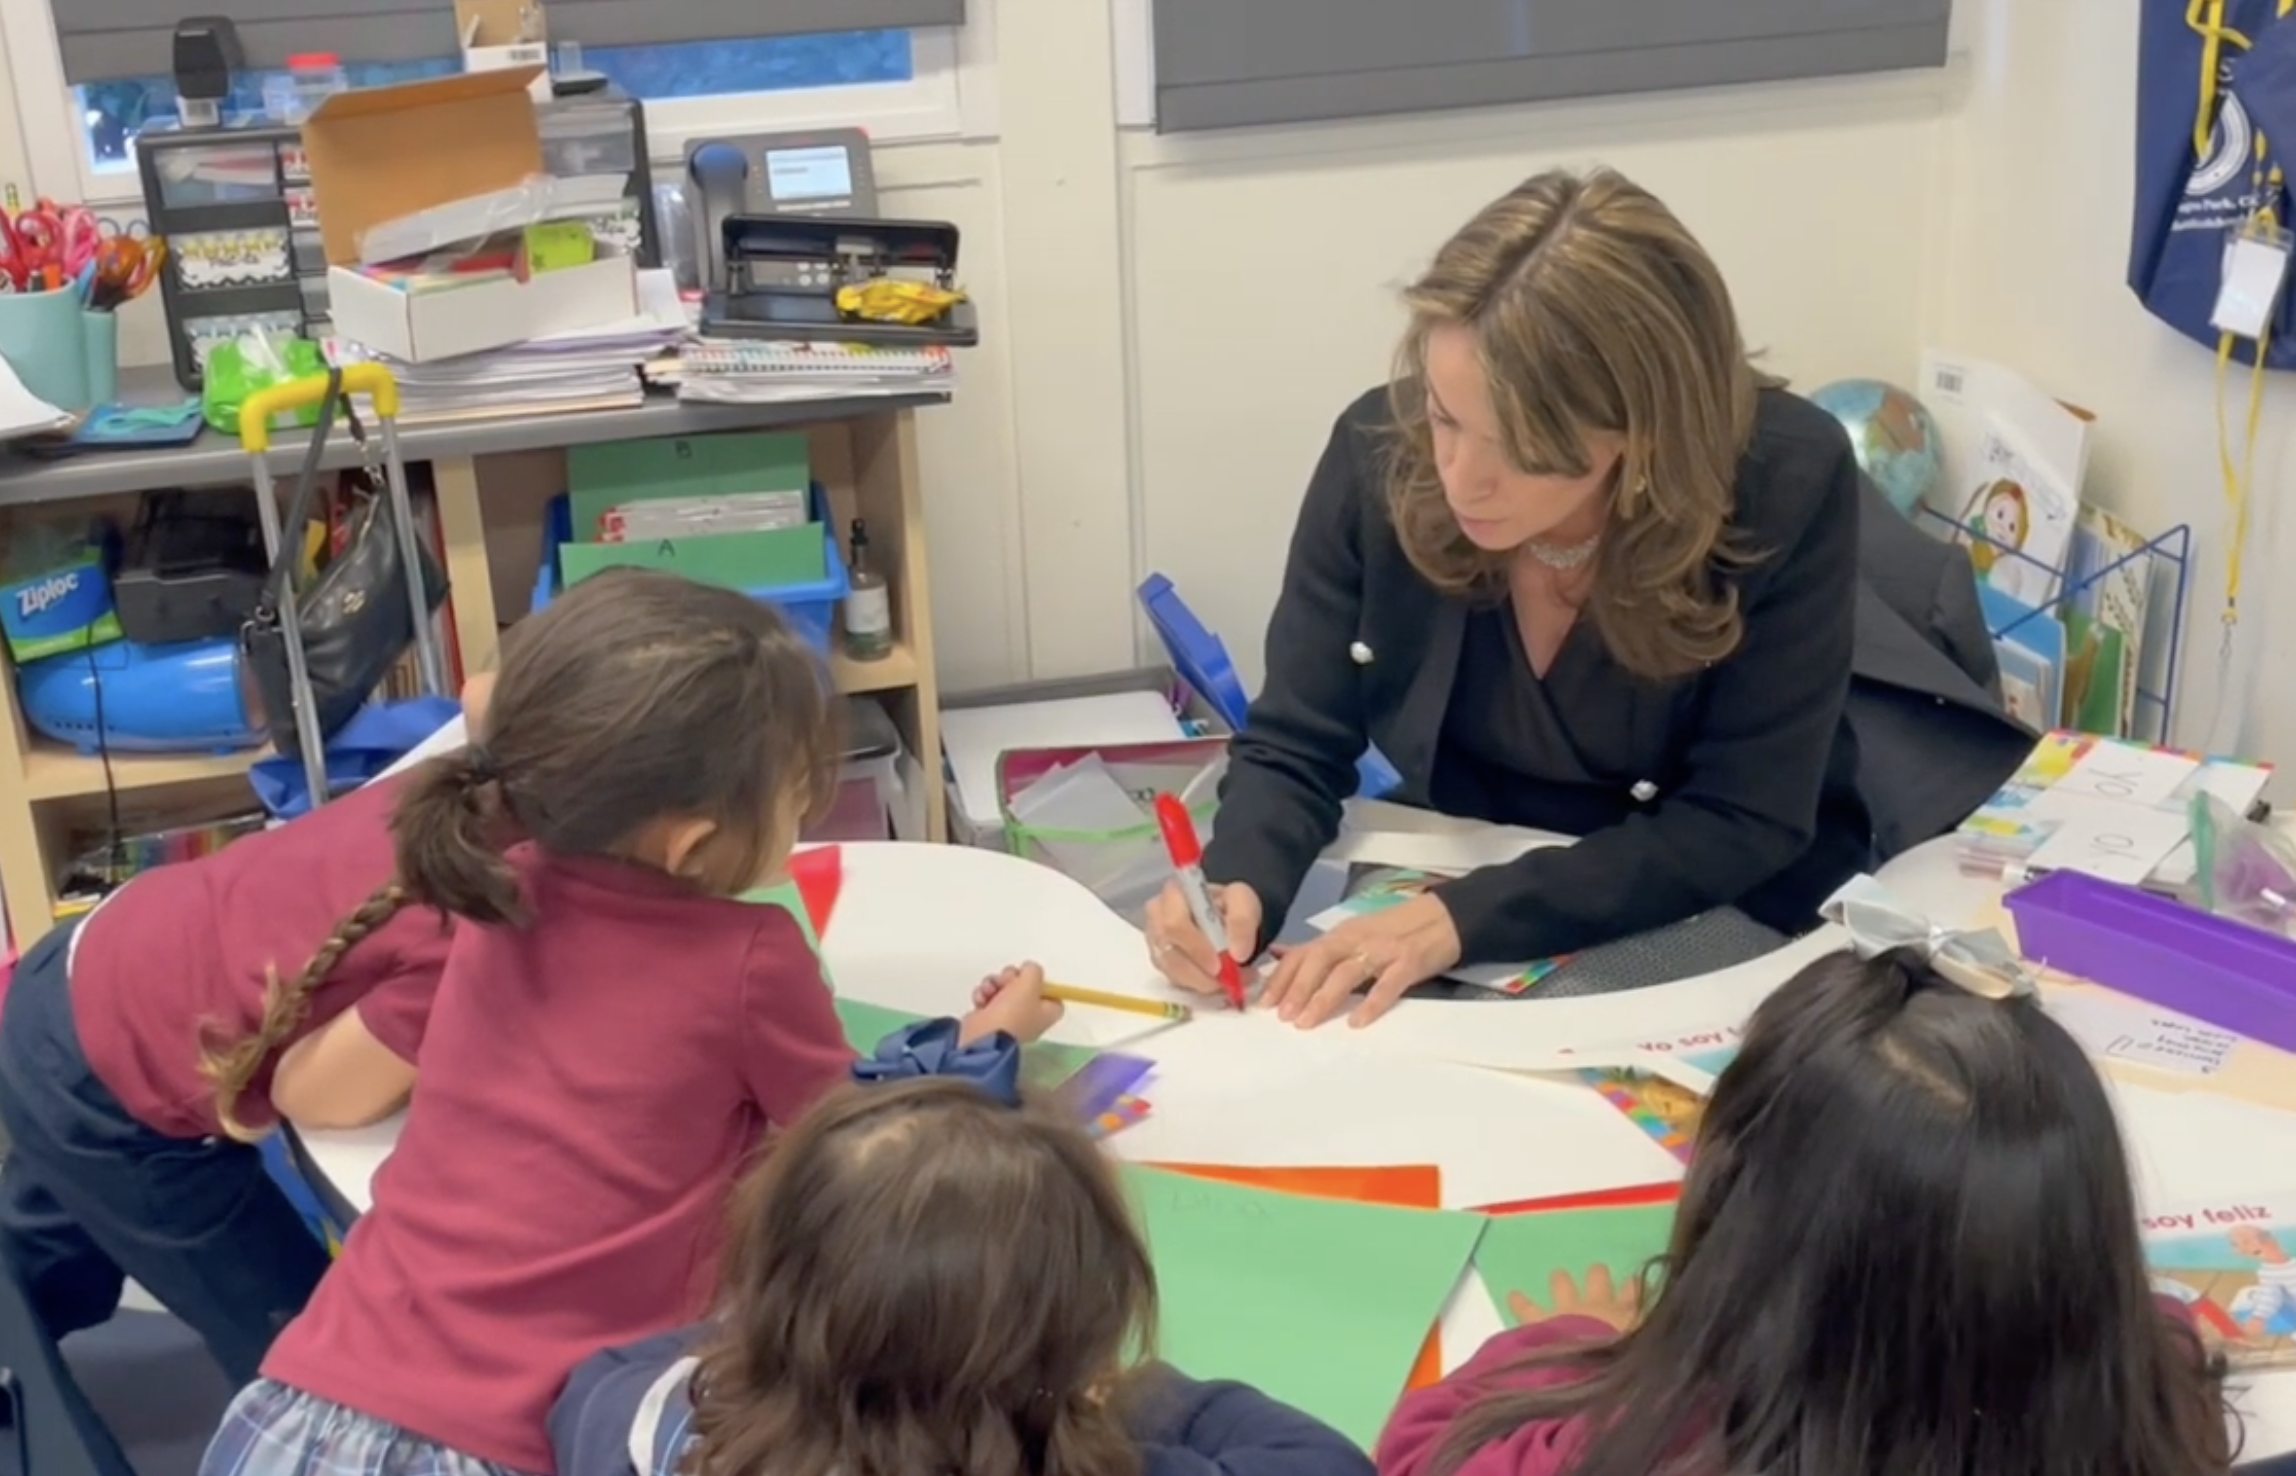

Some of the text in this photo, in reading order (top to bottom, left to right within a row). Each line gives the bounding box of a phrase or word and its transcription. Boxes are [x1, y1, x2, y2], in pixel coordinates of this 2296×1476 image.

[675, 440, 693, 459] B
[656, 539, 676, 558] A
[15, 573, 79, 616] Ziploc
[1678, 1031, 1723, 1046] soy
[2141, 1204, 2272, 1230] soy feliz
